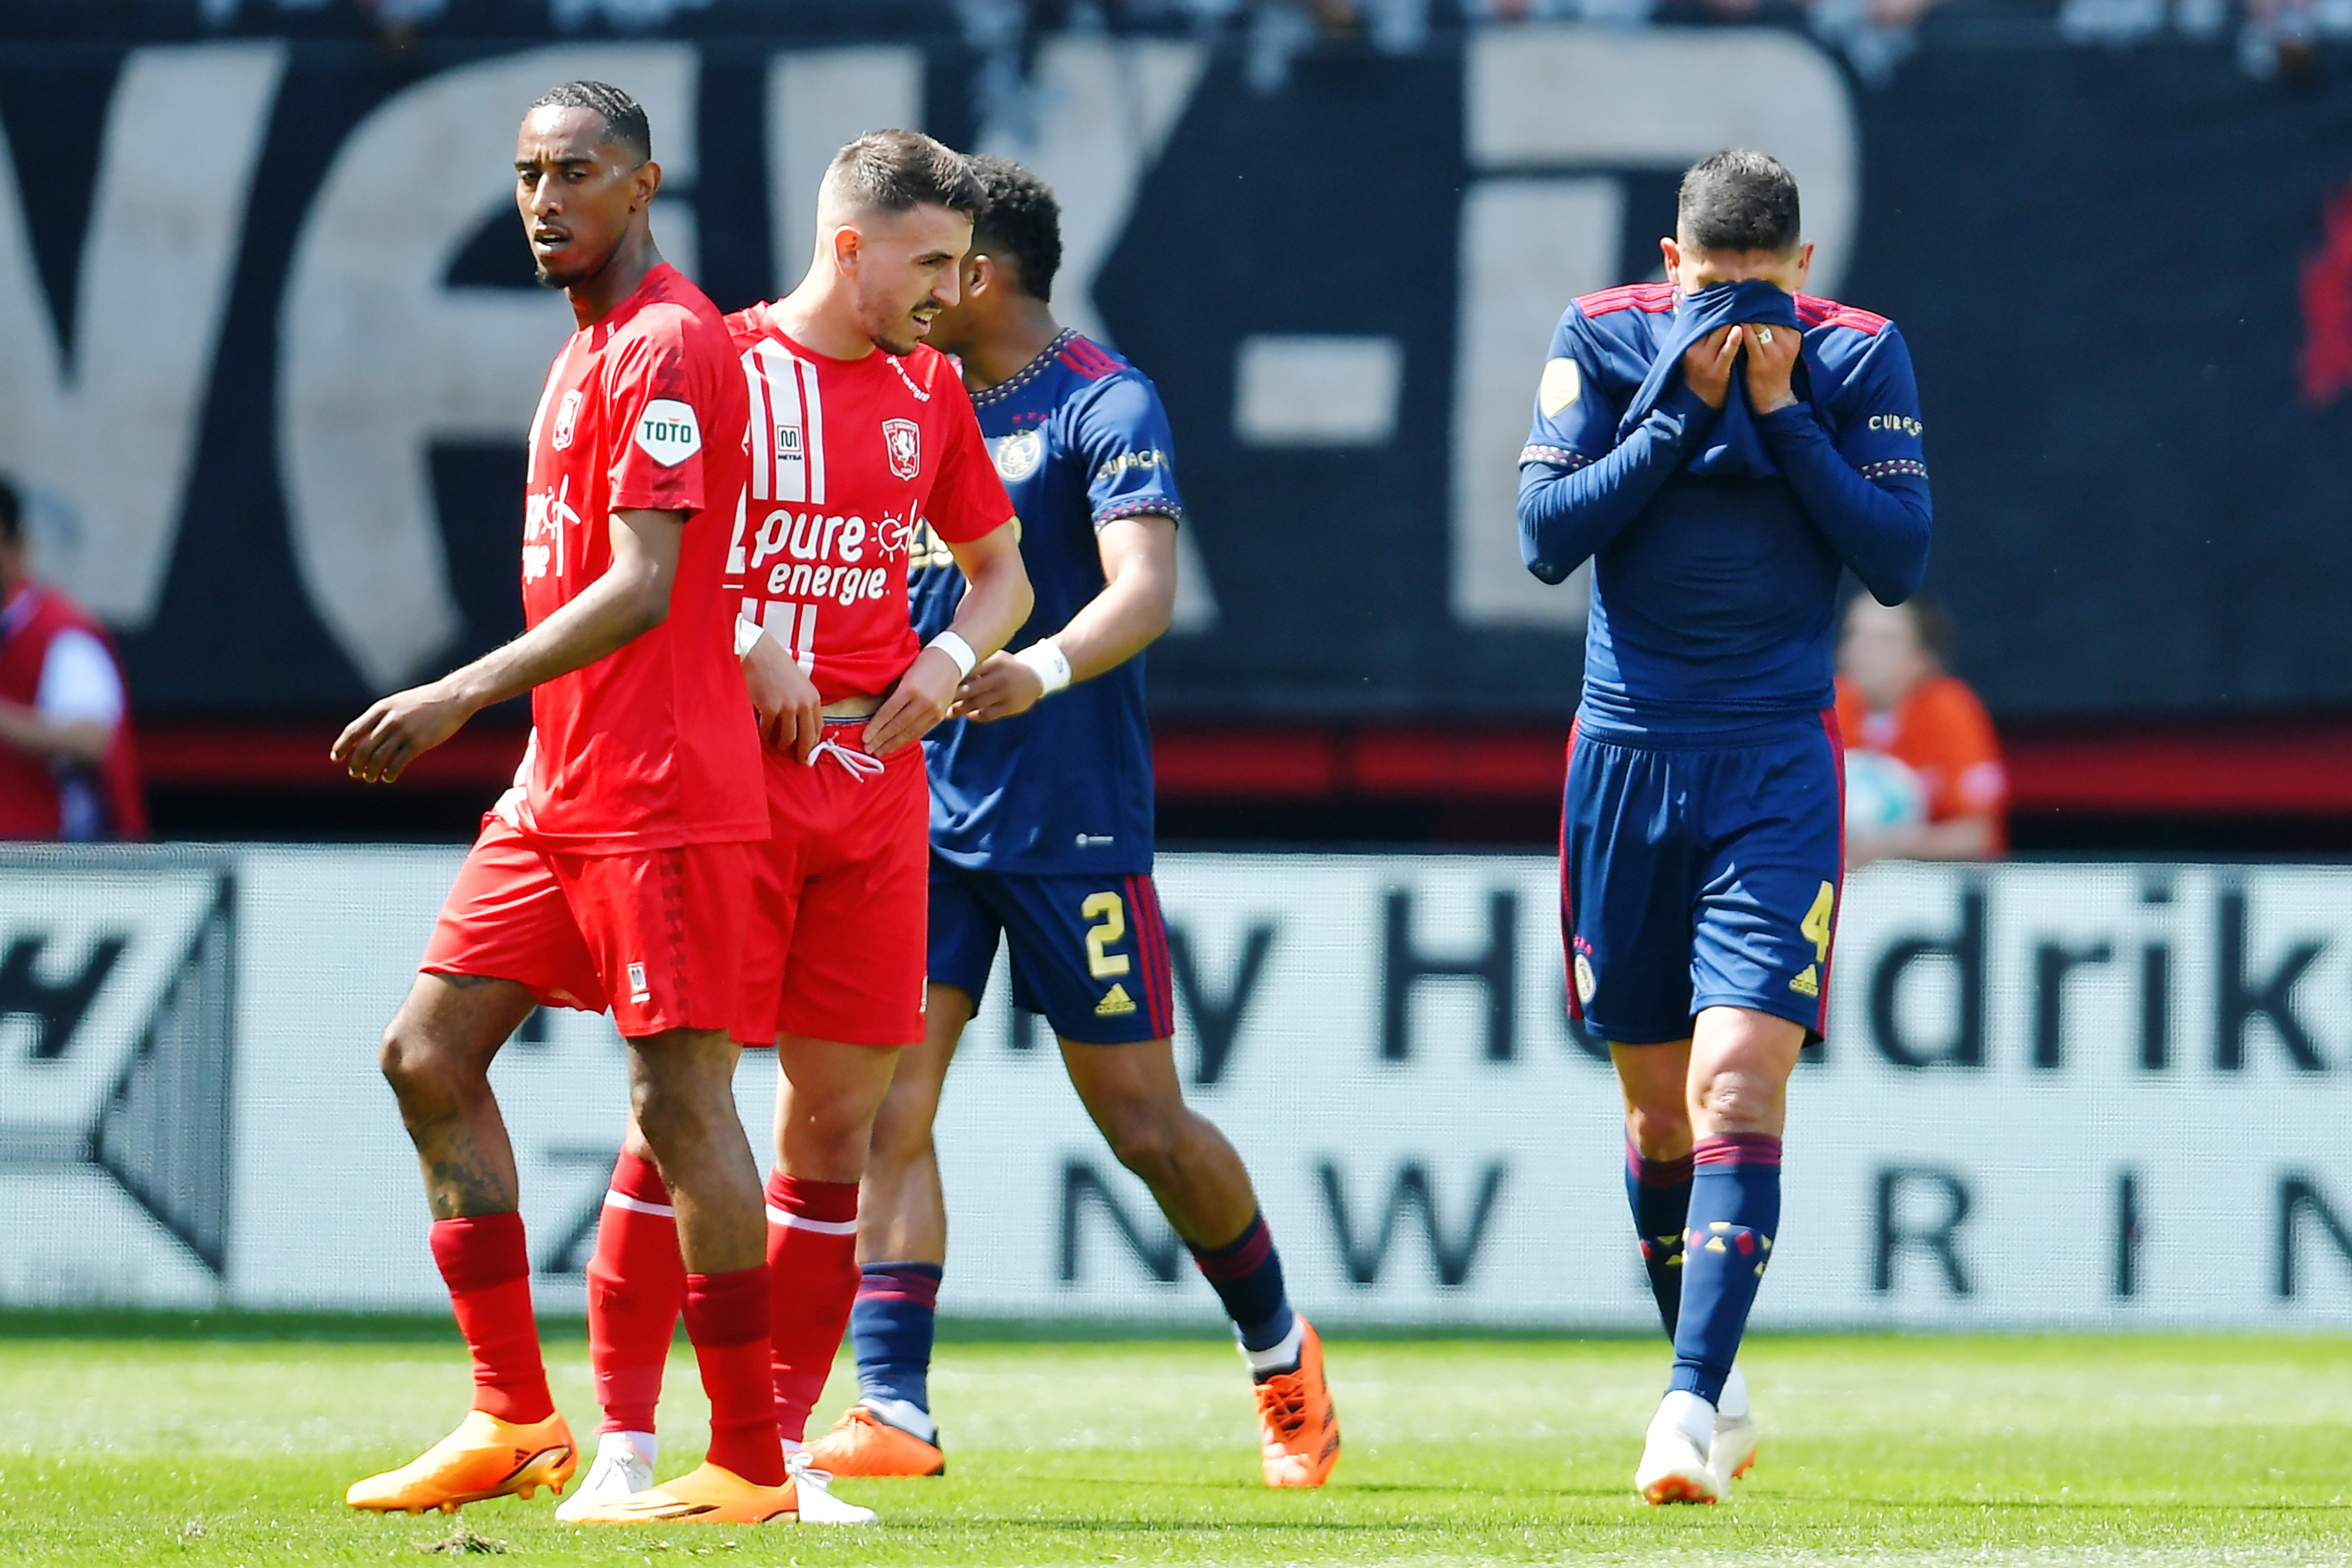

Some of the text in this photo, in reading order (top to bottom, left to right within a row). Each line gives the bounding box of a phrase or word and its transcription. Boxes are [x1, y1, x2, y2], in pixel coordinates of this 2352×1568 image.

[644, 420, 691, 444] TOTO
[751, 509, 866, 569] pure
[1081, 891, 1130, 979] 2
[1800, 880, 1835, 963] 4
[1379, 885, 2327, 1071] Hdrik
